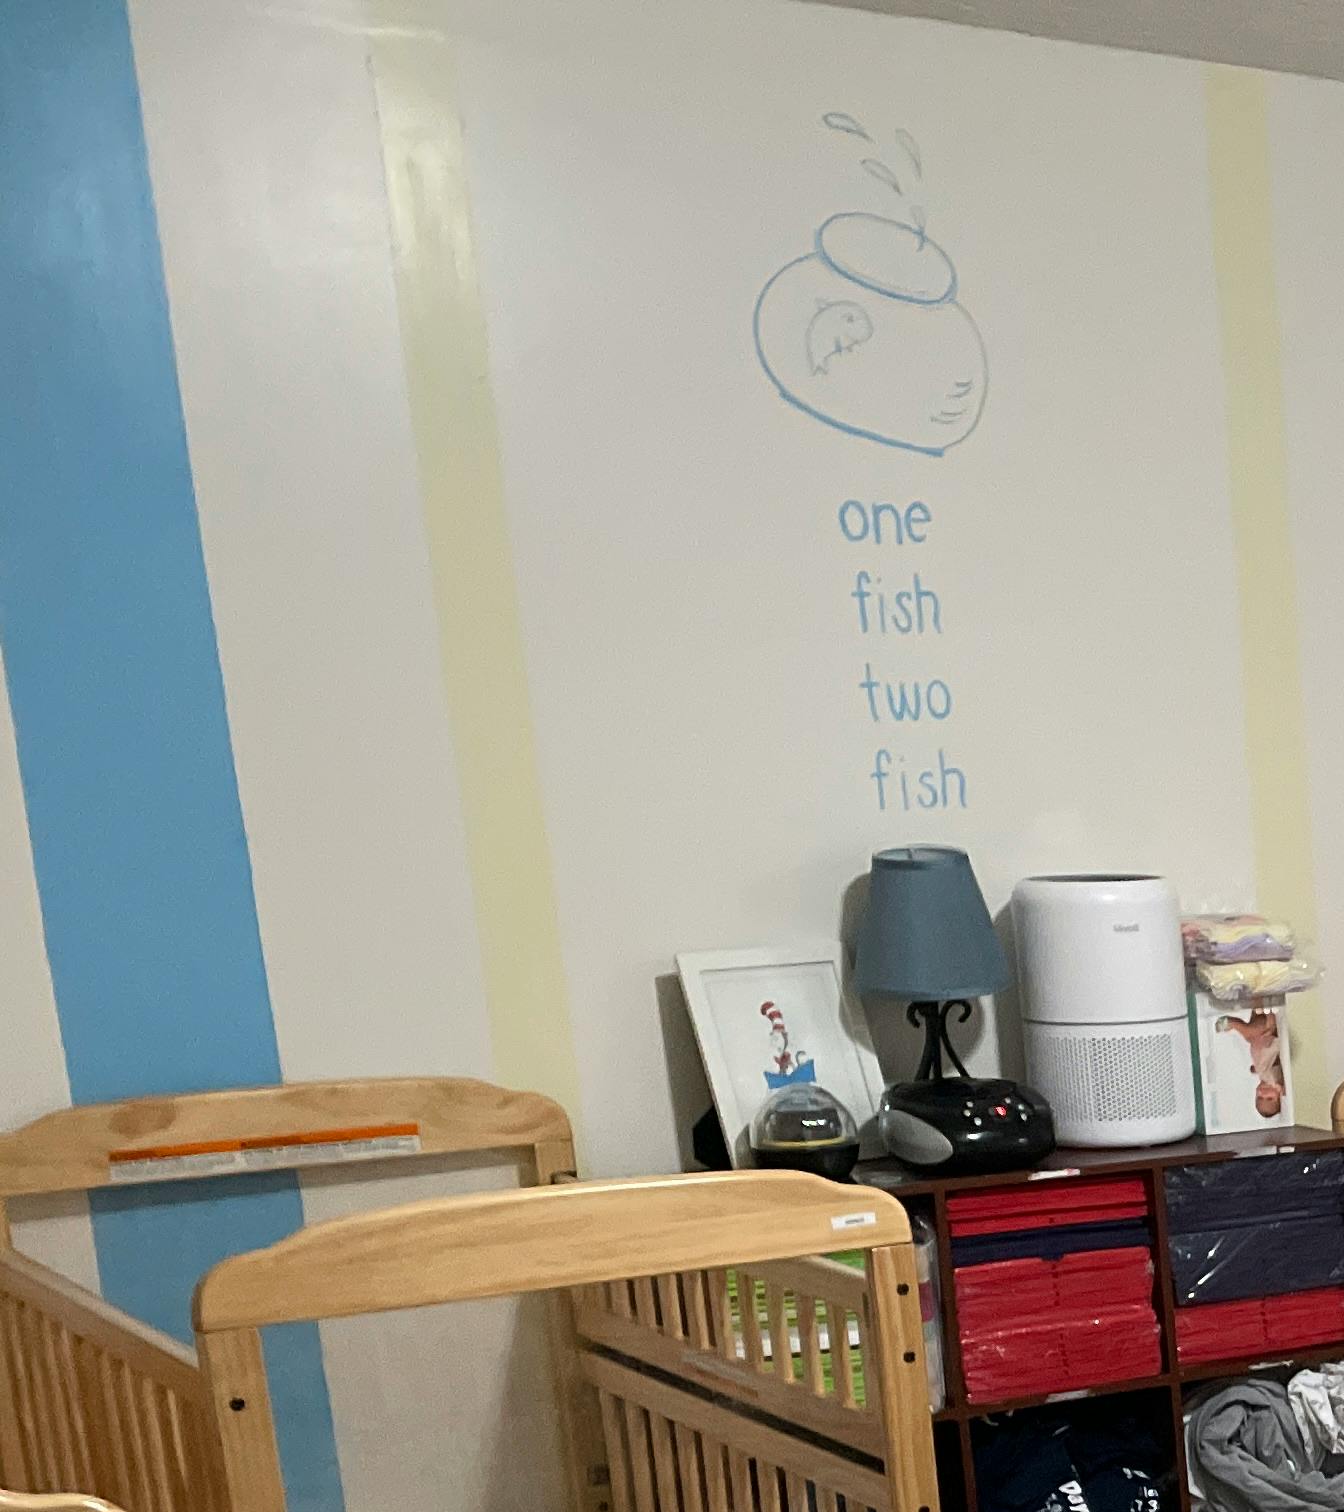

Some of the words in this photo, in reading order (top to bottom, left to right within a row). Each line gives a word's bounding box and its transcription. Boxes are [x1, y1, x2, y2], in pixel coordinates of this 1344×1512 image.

[838, 499, 932, 545] one
[850, 570, 942, 634] fish
[859, 661, 951, 722] two
[869, 748, 967, 811] fish
